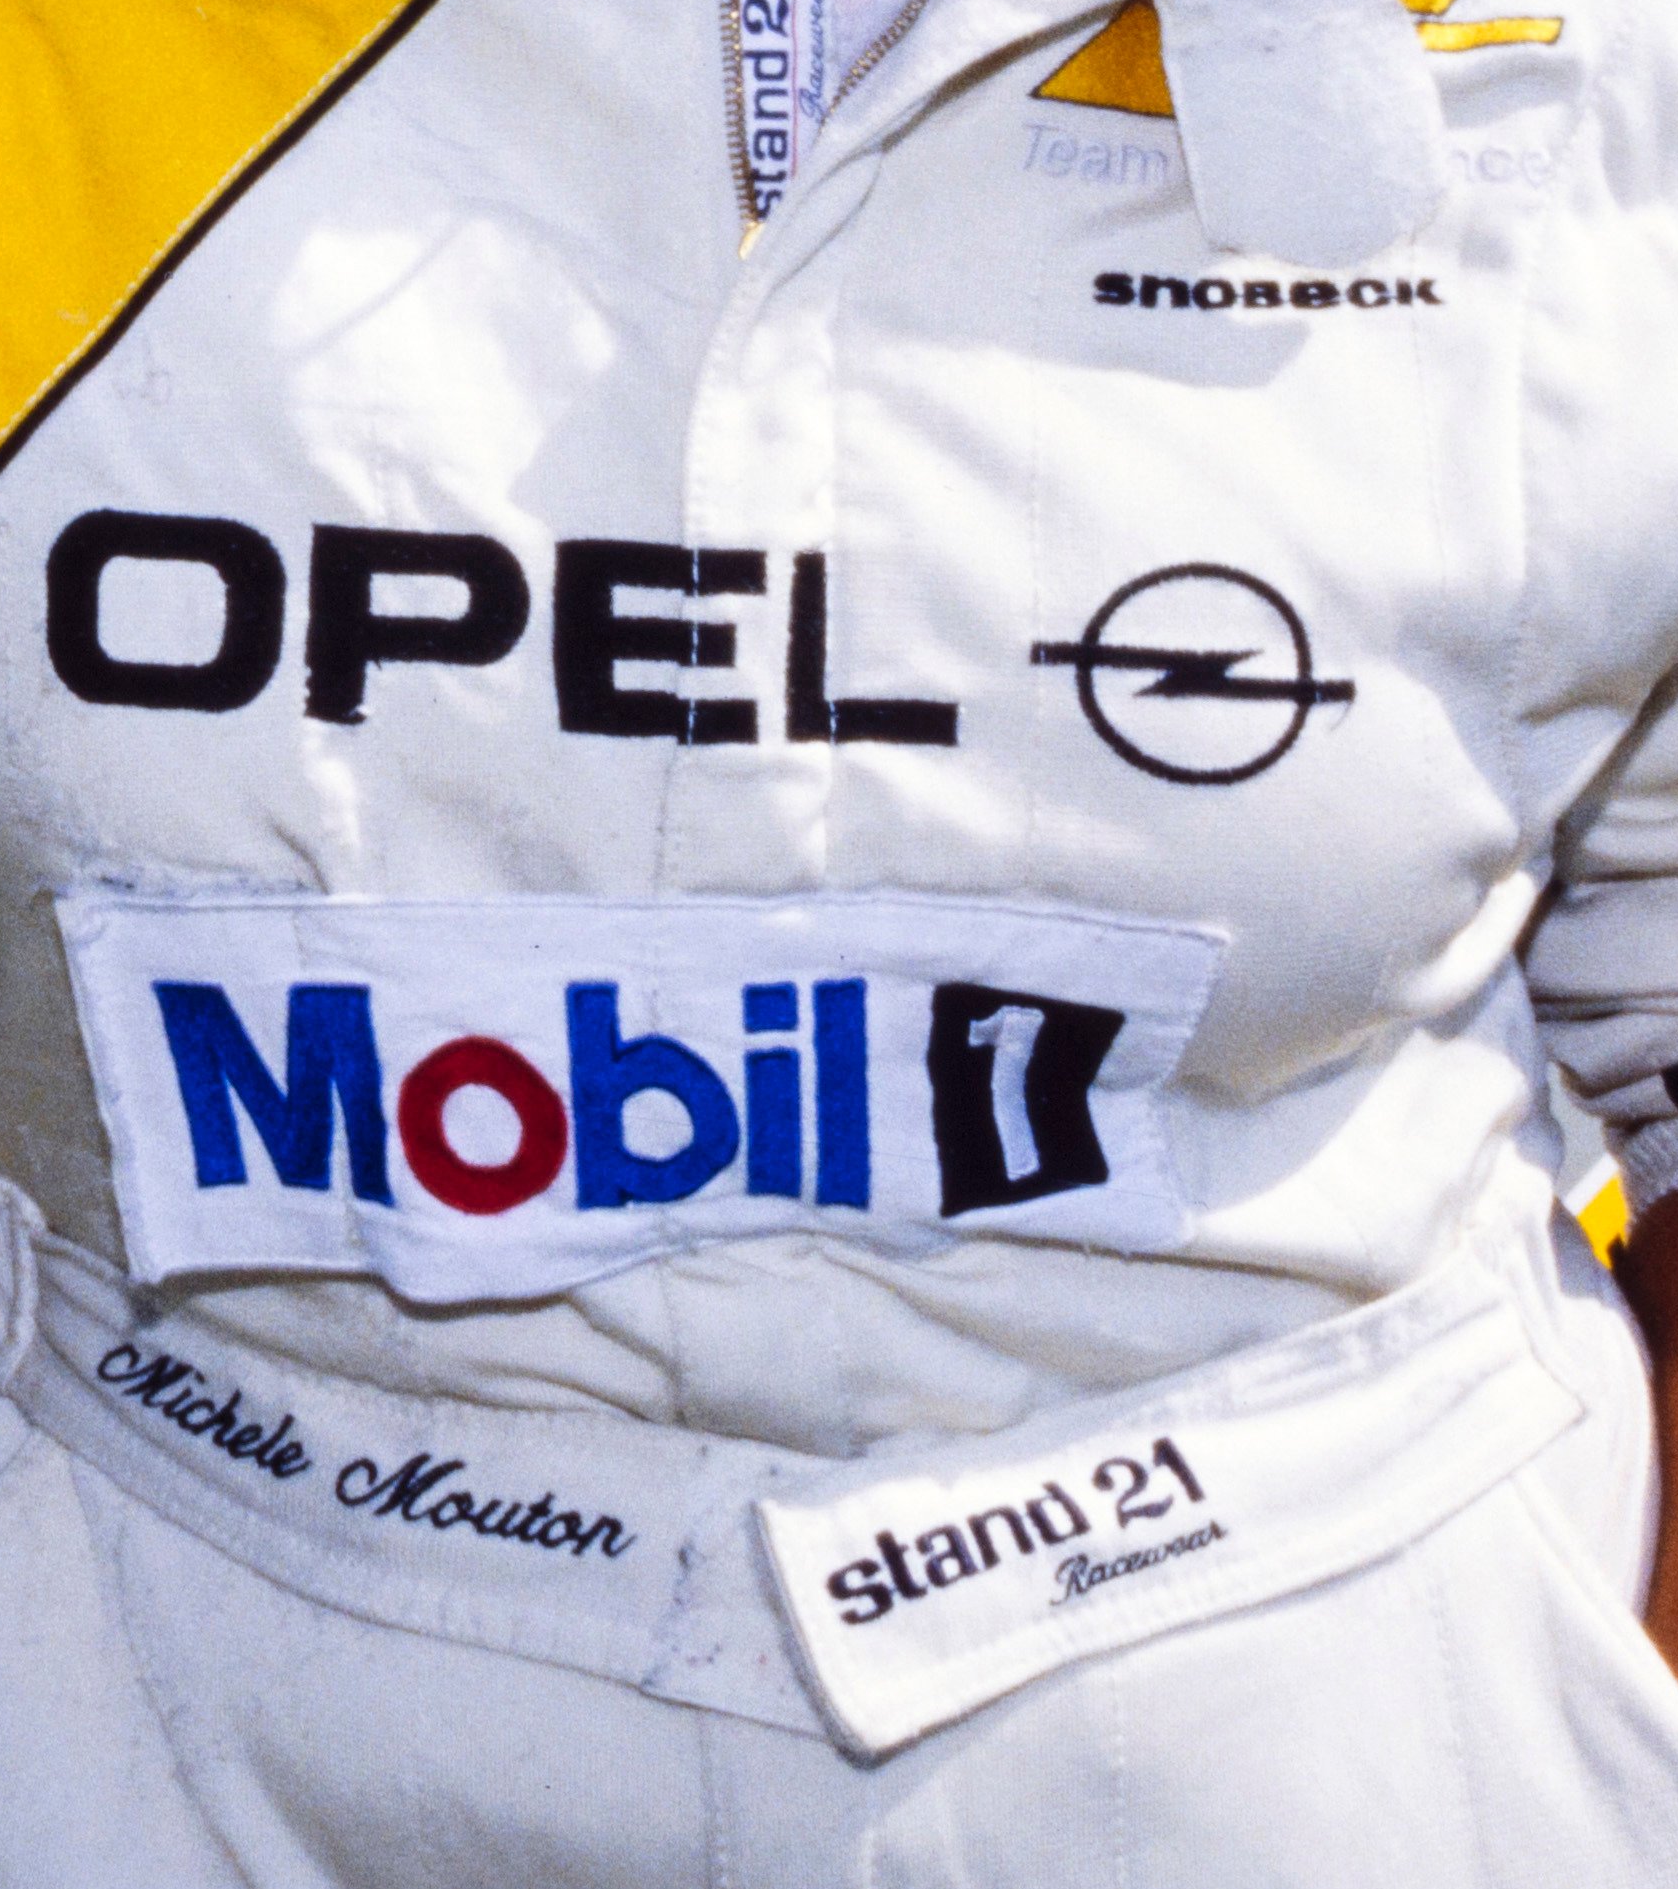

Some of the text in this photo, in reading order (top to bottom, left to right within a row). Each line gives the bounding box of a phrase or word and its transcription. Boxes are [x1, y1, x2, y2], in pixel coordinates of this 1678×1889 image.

[742, 49, 789, 221] stand
[1022, 124, 1169, 185] Team
[45, 508, 960, 746] OPEL
[152, 976, 871, 1215] Mobil
[96, 1341, 636, 1559] Michele Mouton
[826, 1436, 1206, 1626] stand 21
[1049, 1519, 1229, 1607] Racewear
